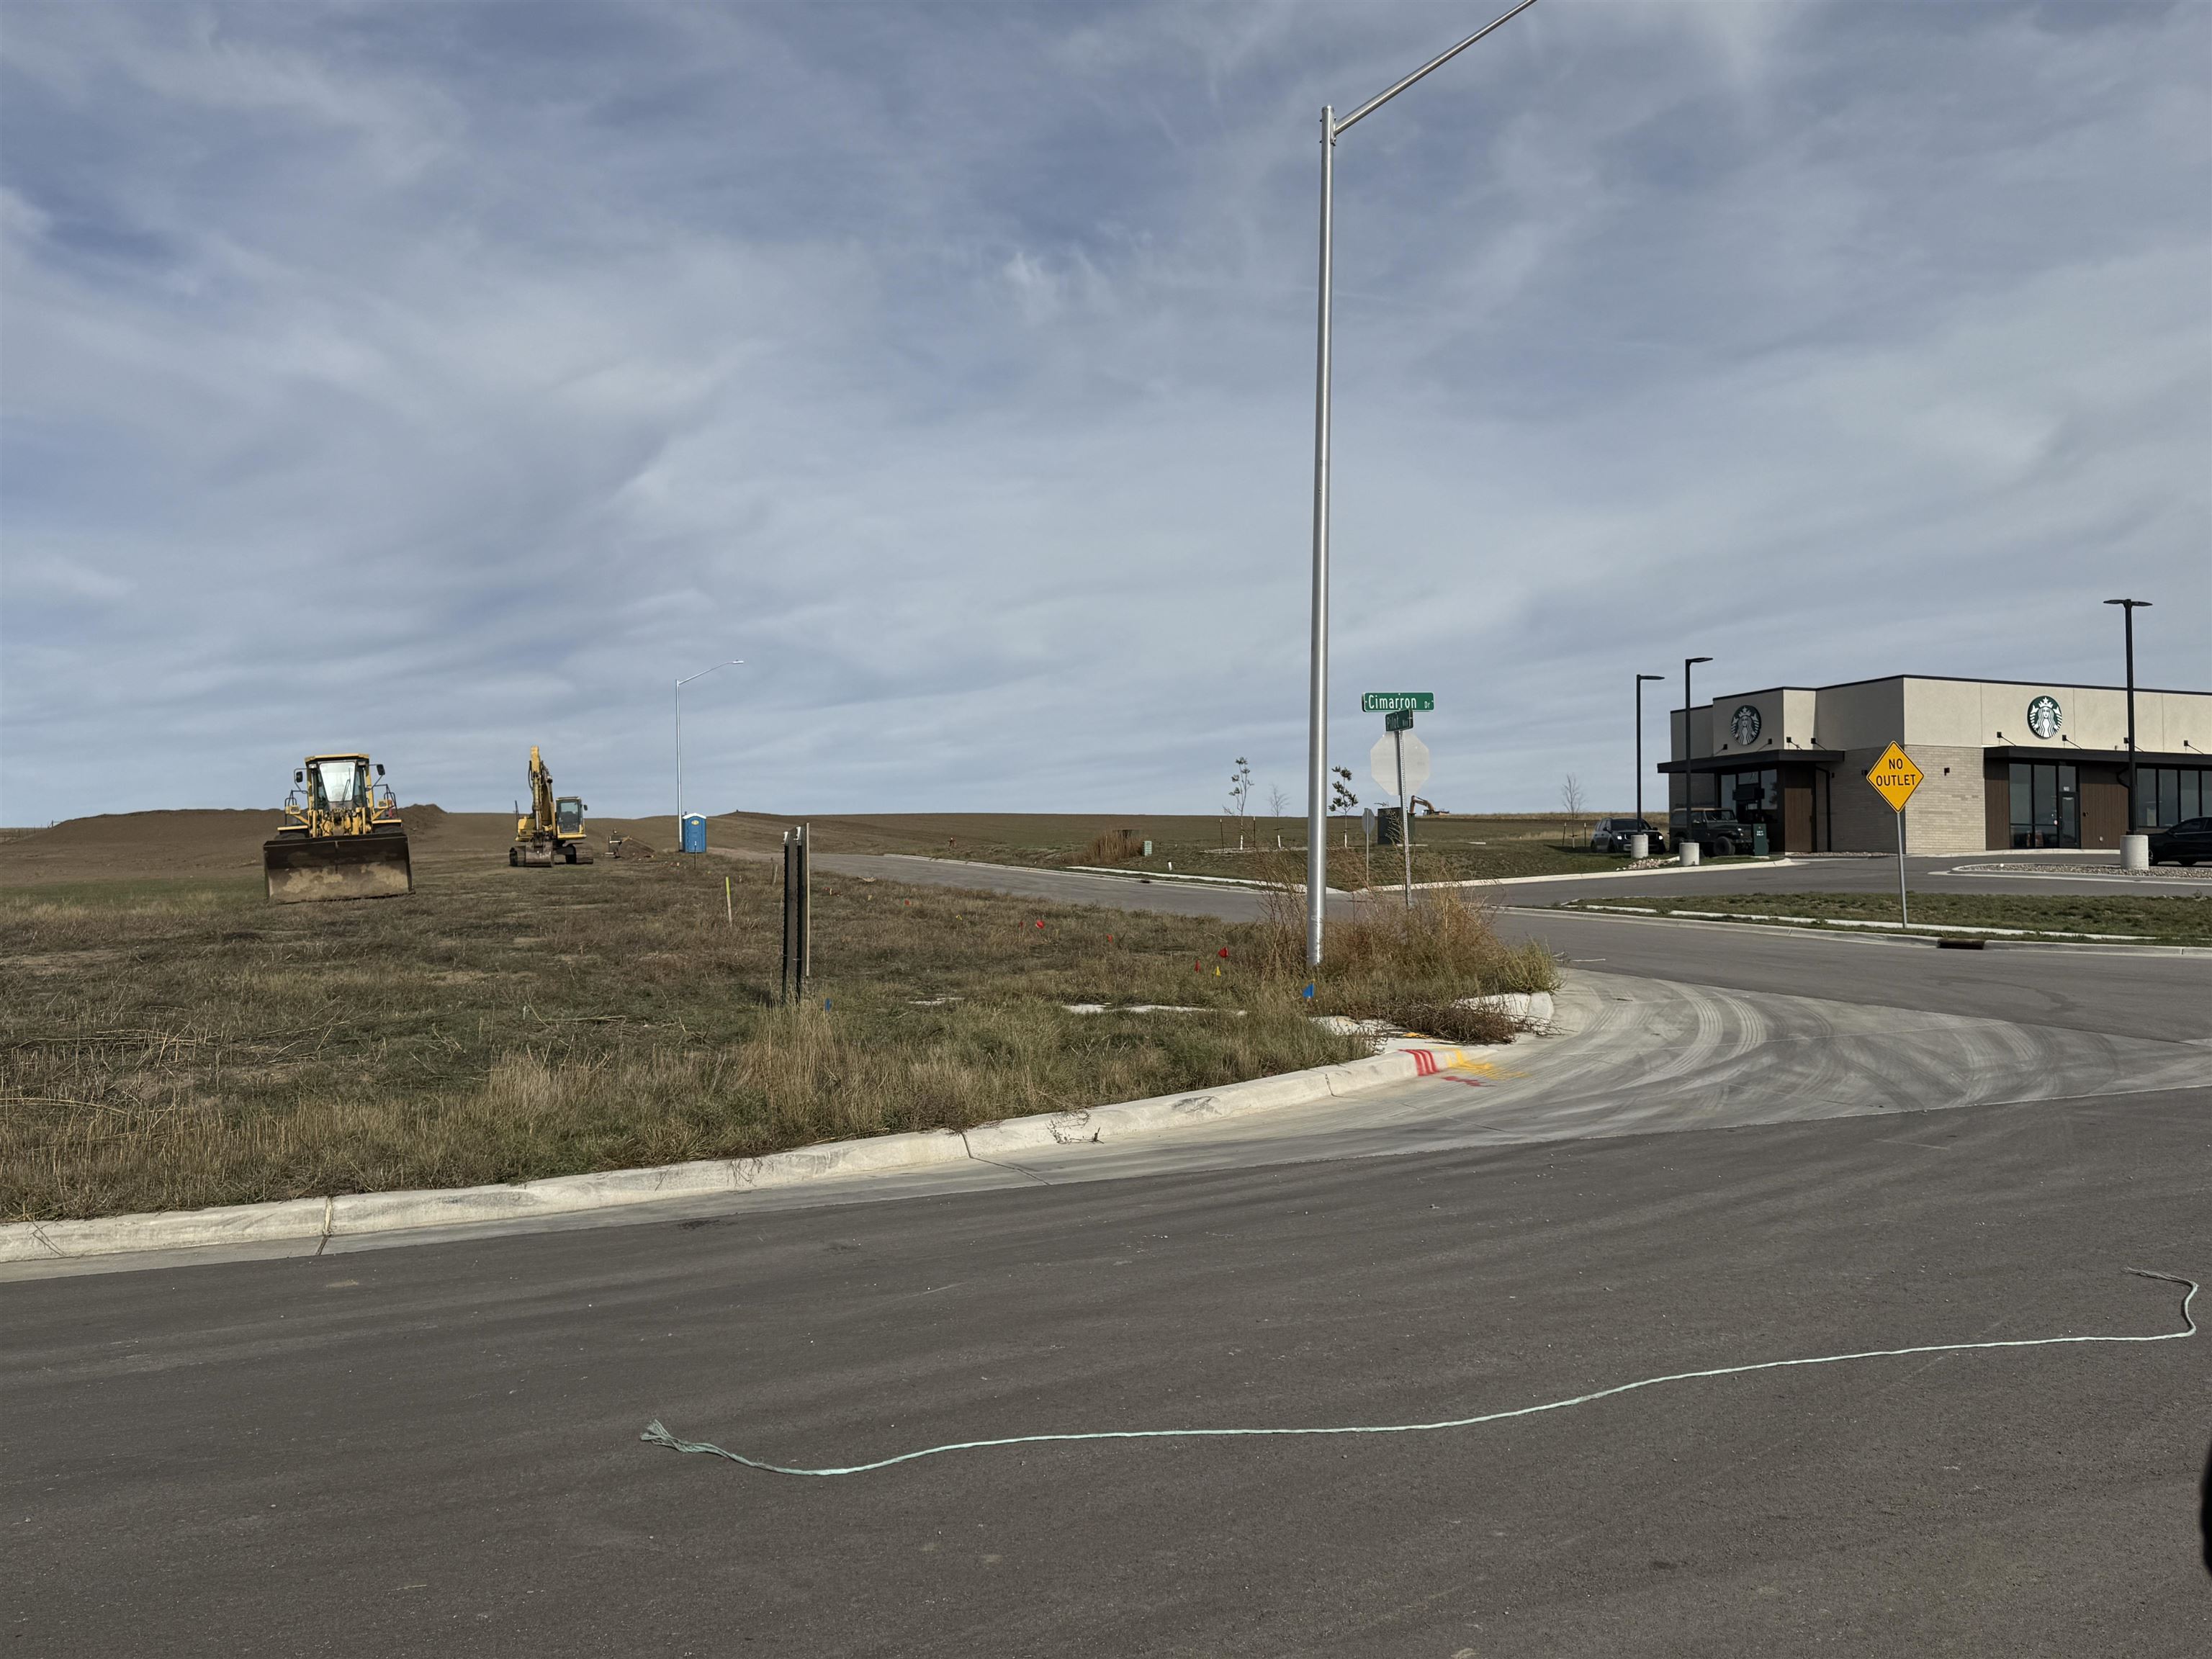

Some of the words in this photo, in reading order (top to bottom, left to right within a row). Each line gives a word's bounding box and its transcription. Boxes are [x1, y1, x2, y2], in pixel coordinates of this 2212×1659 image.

[1368, 694, 1416, 709] Cimarron
[1889, 758, 1903, 770] NO
[1876, 774, 1915, 786] OUTLET
